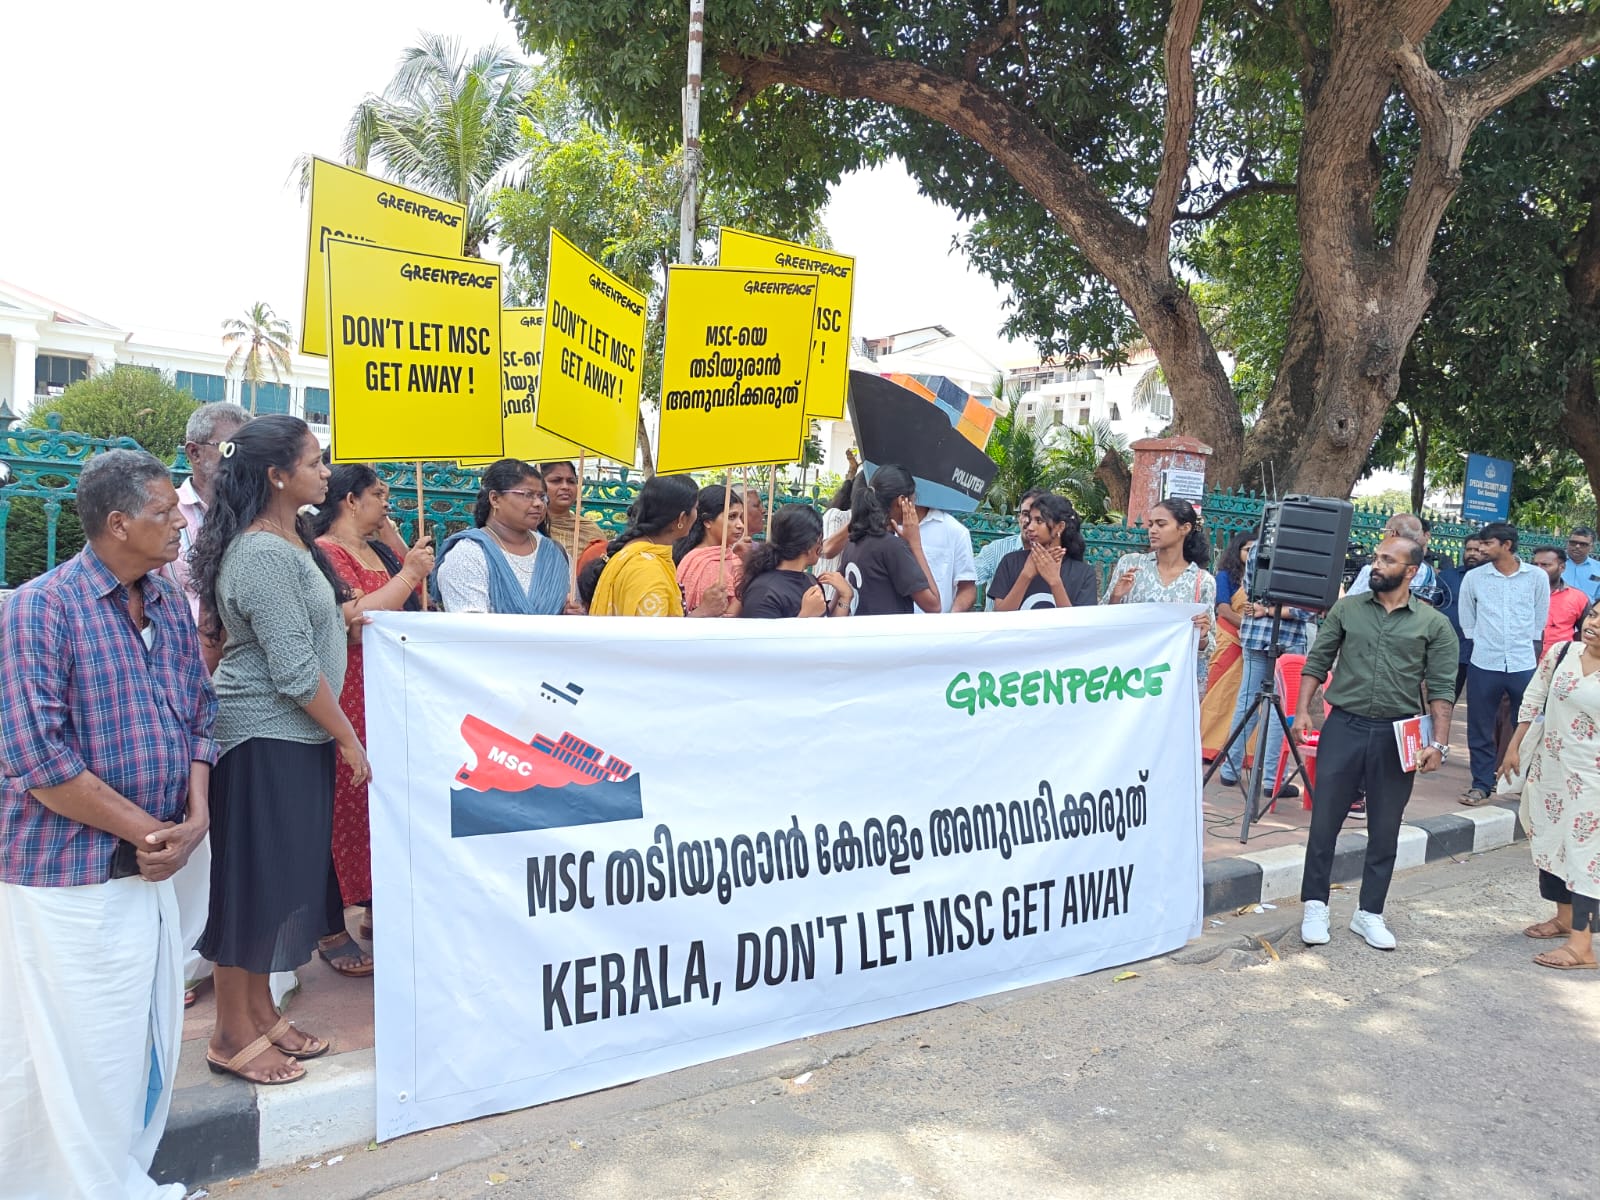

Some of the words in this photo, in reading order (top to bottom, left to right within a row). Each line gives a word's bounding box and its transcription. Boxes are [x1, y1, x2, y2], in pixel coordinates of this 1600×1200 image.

[377, 191, 462, 228] GREENPEACE
[400, 262, 497, 290] GREENPEACE
[776, 252, 851, 279] GREENPEACE
[589, 273, 644, 317] GREENPEACE
[743, 280, 816, 296] GREENPEACE
[342, 314, 404, 350] DON'T
[409, 321, 443, 352] LET
[448, 325, 491, 355] MSC
[552, 300, 587, 345] DON'T
[588, 324, 609, 358] LET
[610, 336, 636, 373] MSC
[705, 325, 768, 347] MSC-യെ
[365, 361, 403, 393] GET
[407, 363, 463, 394] AWAY
[561, 347, 583, 382] GET
[584, 362, 617, 400] AWAY
[690, 351, 782, 381] തടിയൂരാൻ
[665, 379, 802, 413] അനുവദിക്കരുത്
[951, 467, 985, 494] POLLUTER
[945, 662, 1171, 716] GREENPEACE
[487, 745, 534, 777] MSC
[526, 850, 595, 917] MSC
[605, 814, 810, 905] തടിയൂരാൻ
[814, 814, 924, 876] കേരളം
[929, 769, 1149, 860] അനുവദിക്കരുത്
[542, 939, 722, 1031] KERALA,
[735, 915, 848, 992] DON'T
[857, 903, 915, 971] LET
[923, 890, 995, 957] MSC
[1002, 879, 1056, 941] GET
[1061, 863, 1134, 927] AWAY
